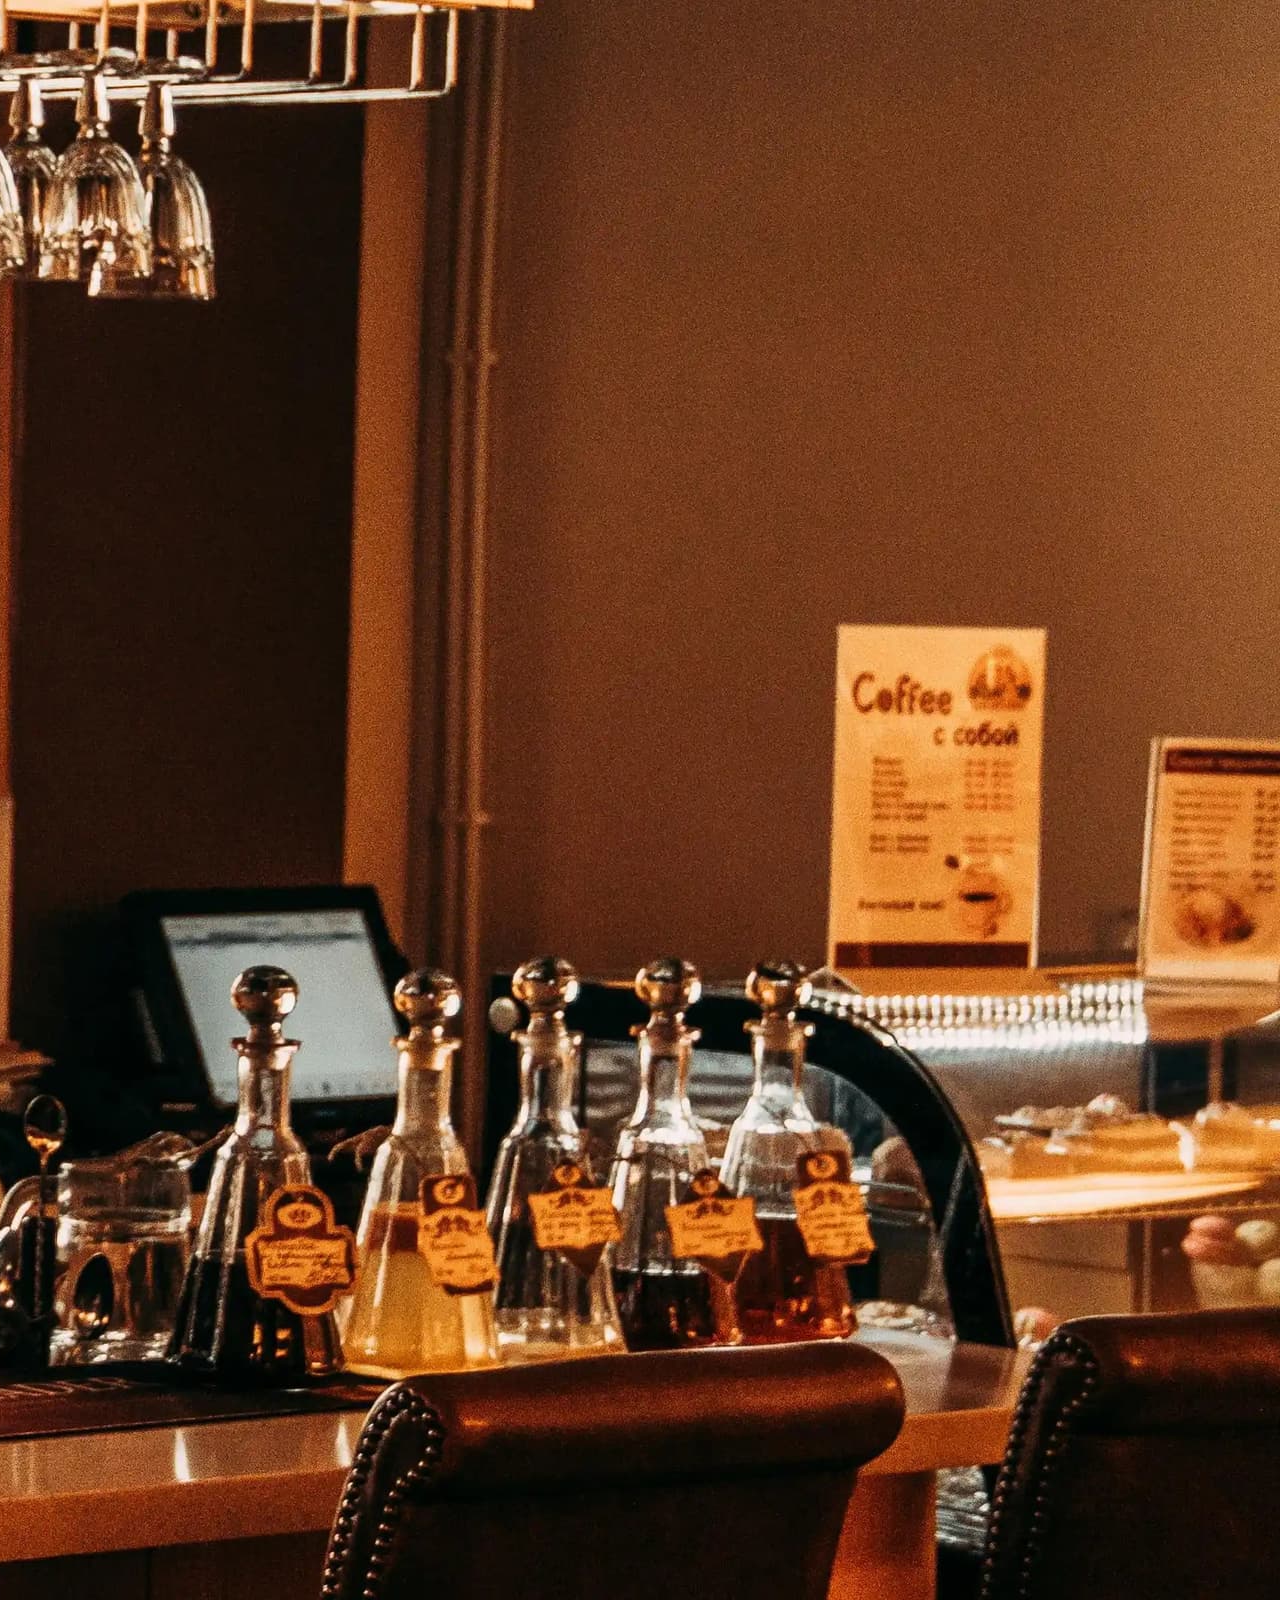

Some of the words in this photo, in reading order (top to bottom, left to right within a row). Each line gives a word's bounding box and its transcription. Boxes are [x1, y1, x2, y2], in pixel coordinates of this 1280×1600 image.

[852, 670, 953, 716] Coffee
[933, 727, 945, 746] с
[953, 720, 1020, 747] собой
